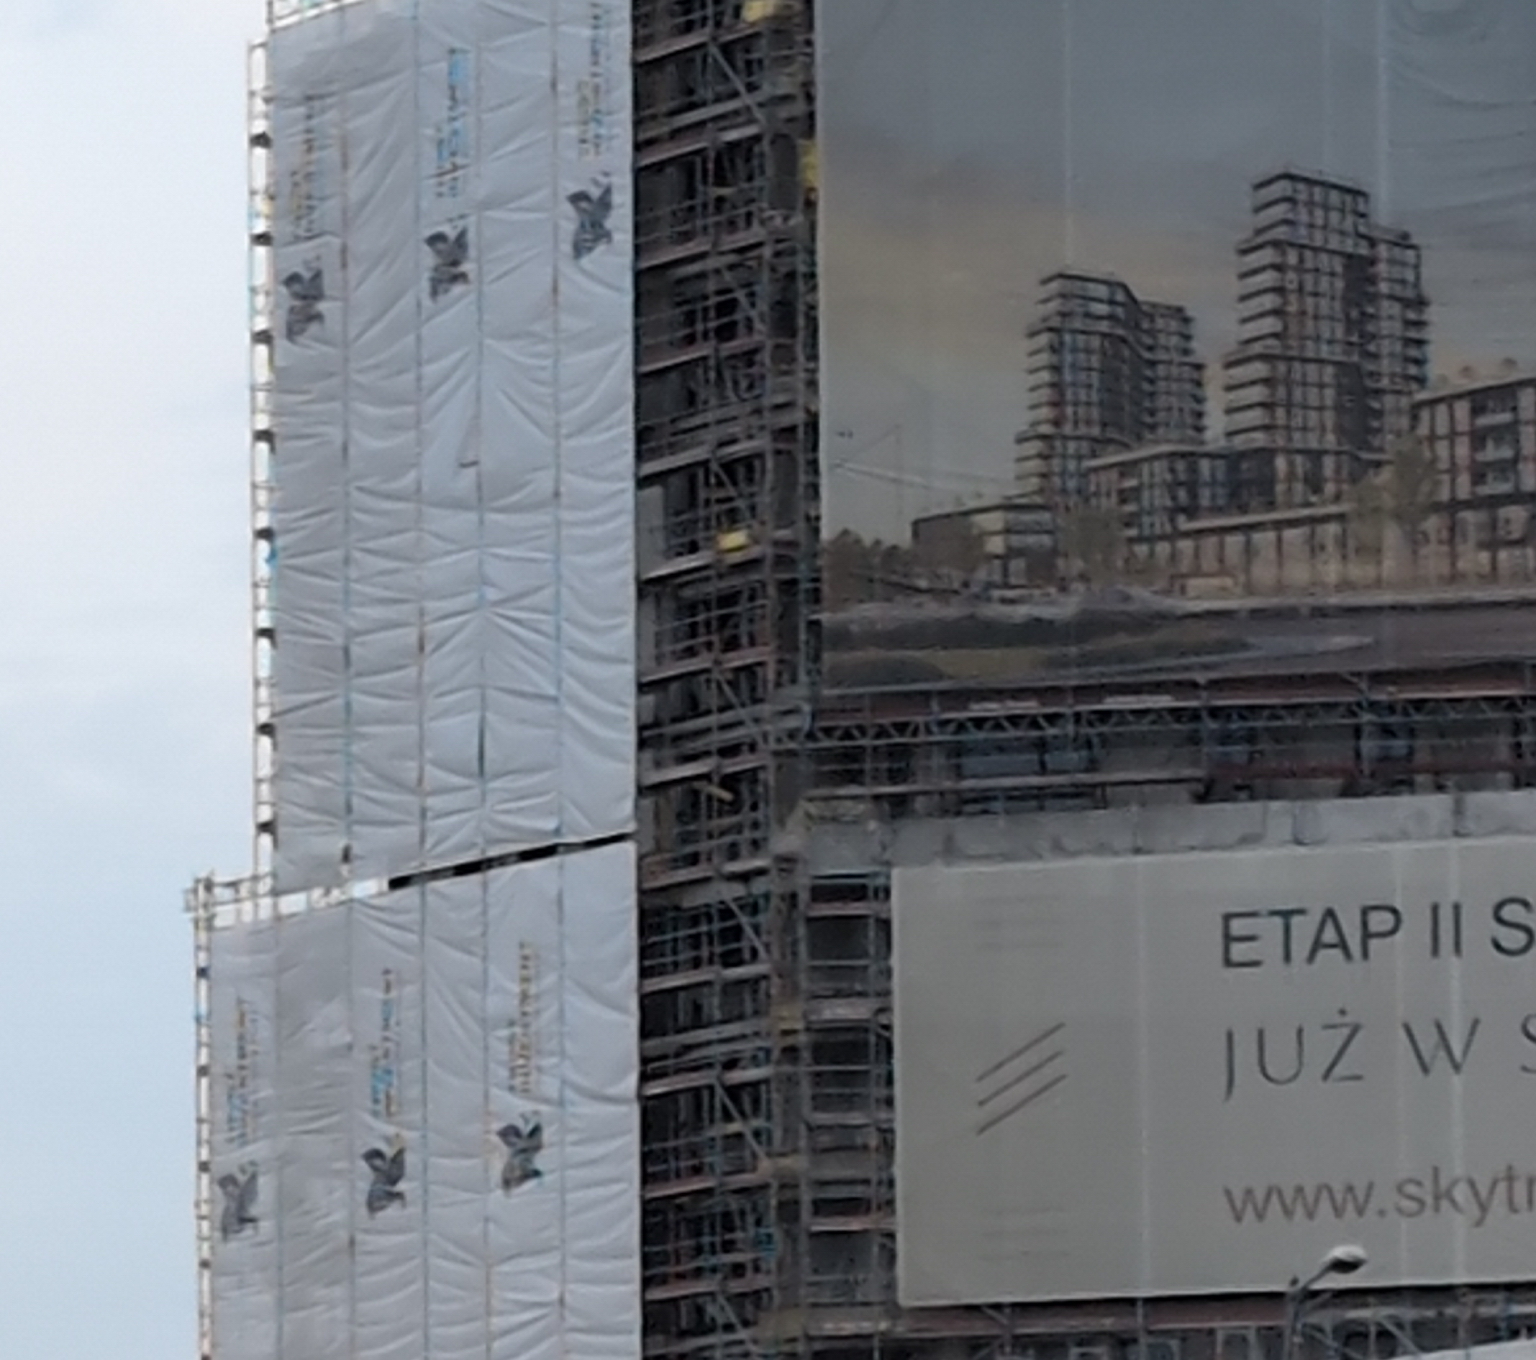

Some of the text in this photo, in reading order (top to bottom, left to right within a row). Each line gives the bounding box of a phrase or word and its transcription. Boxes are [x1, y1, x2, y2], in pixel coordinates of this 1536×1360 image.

[1221, 903, 1402, 968] ETAP
[1430, 902, 1462, 959] II
[1224, 1006, 1364, 1102] JUŻ
[1402, 1016, 1480, 1076] W
